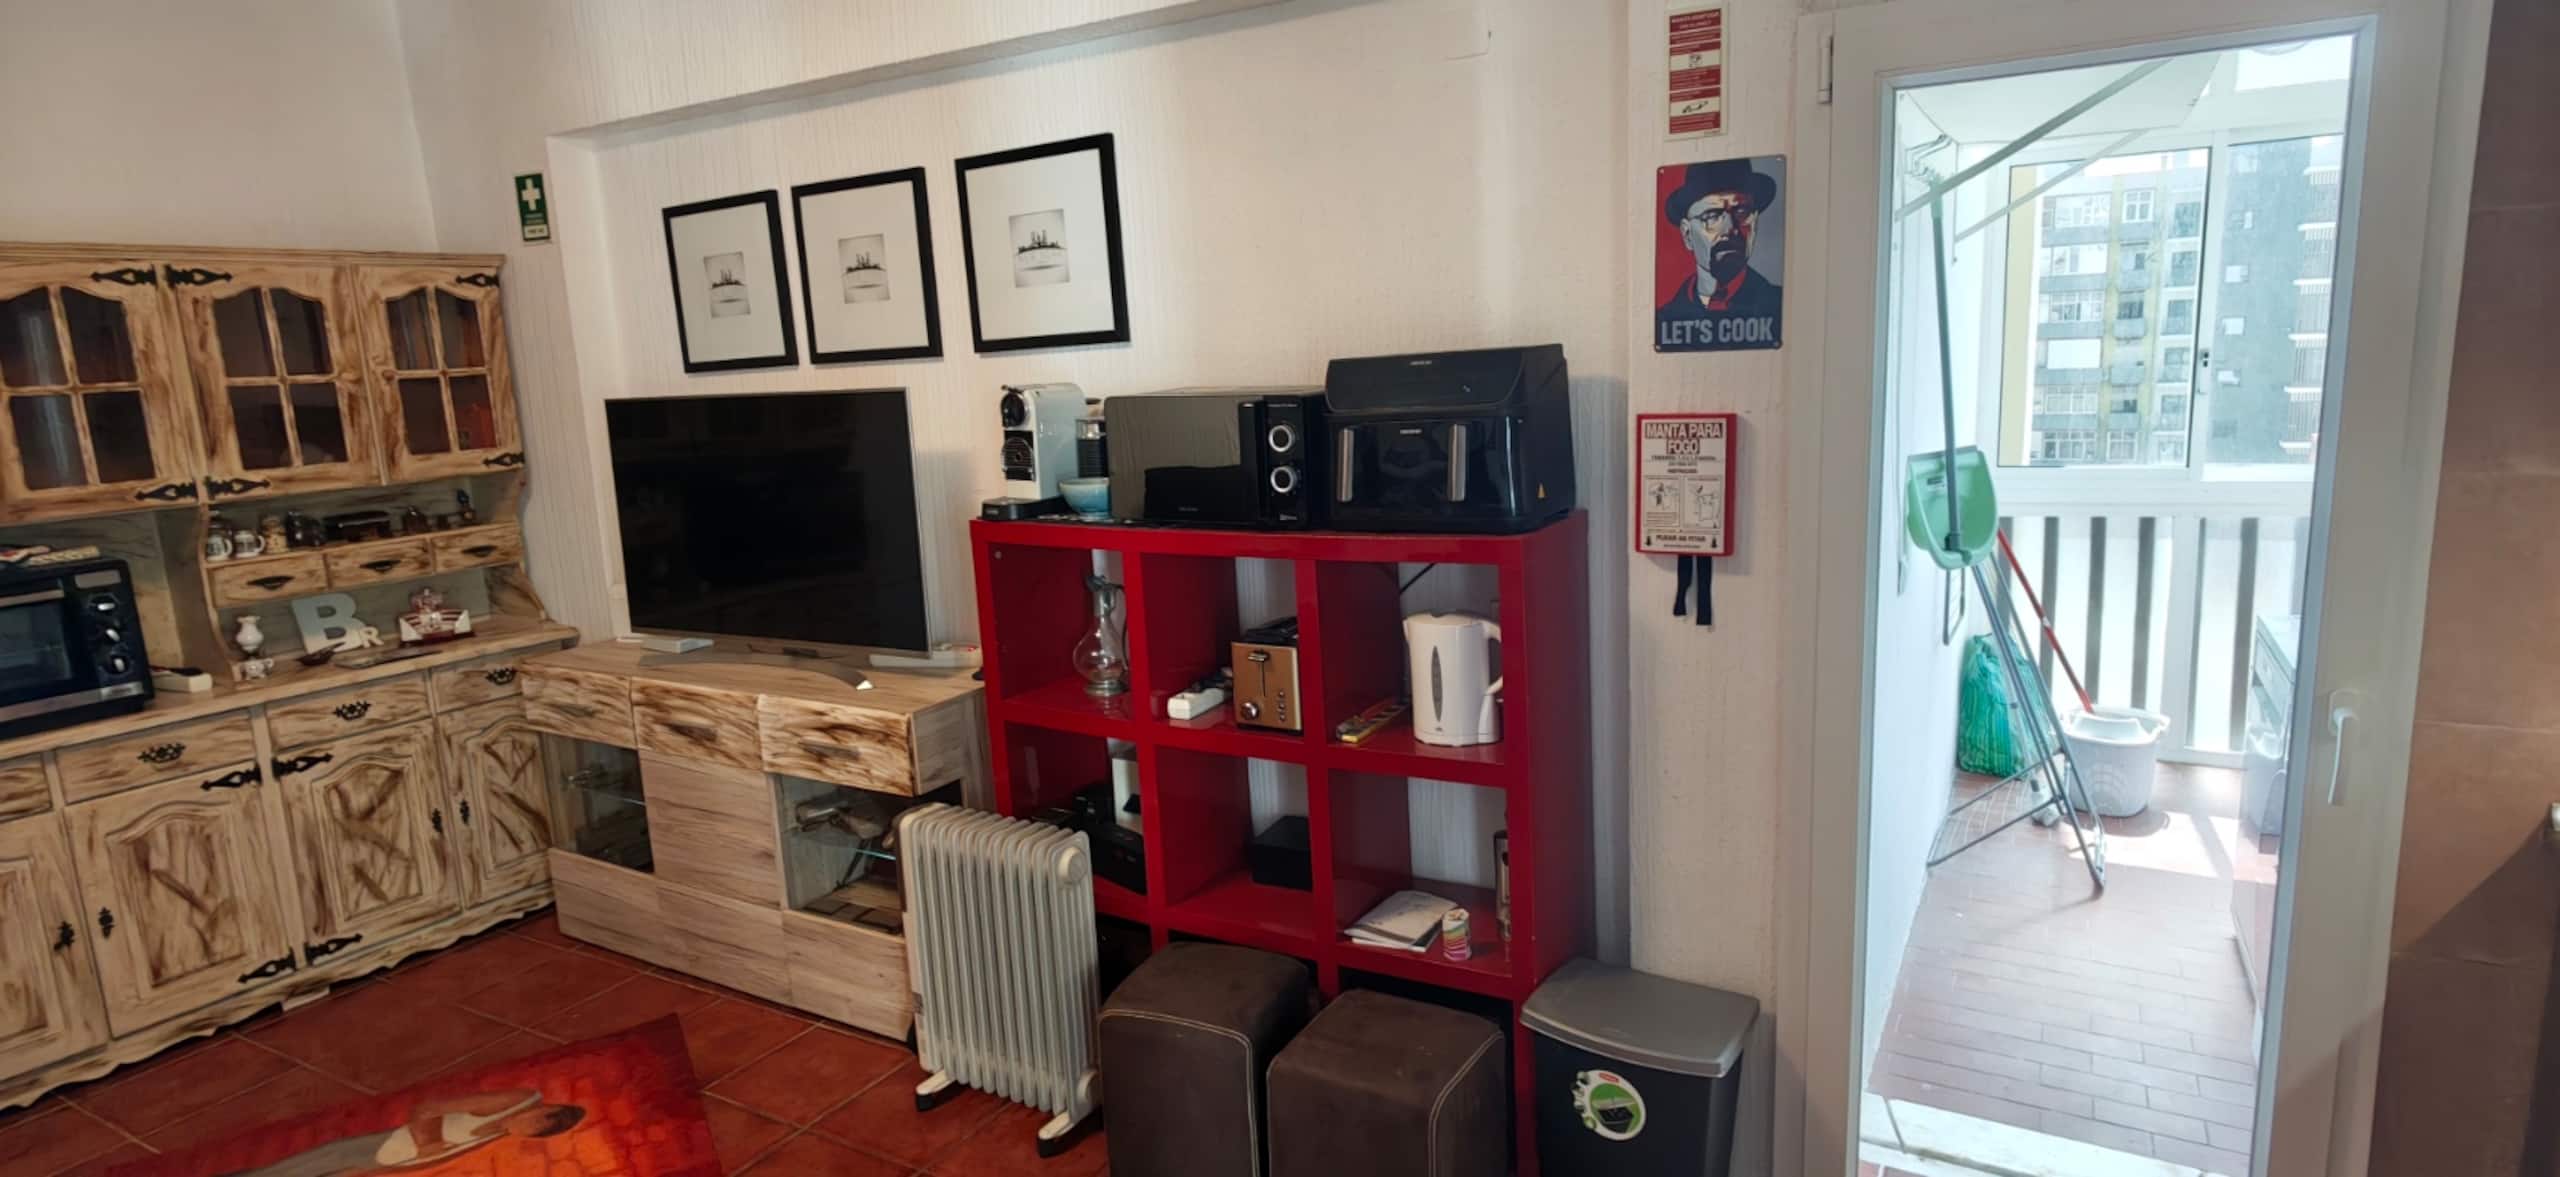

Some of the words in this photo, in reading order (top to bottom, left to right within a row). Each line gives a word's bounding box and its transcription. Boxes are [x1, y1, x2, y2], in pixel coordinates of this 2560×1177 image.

[1661, 319, 1713, 345] LET'S
[1718, 317, 1774, 342] COOK
[1646, 422, 1686, 438] MANTA
[1688, 422, 1722, 438] PARA
[1668, 439, 1699, 454] FOGO
